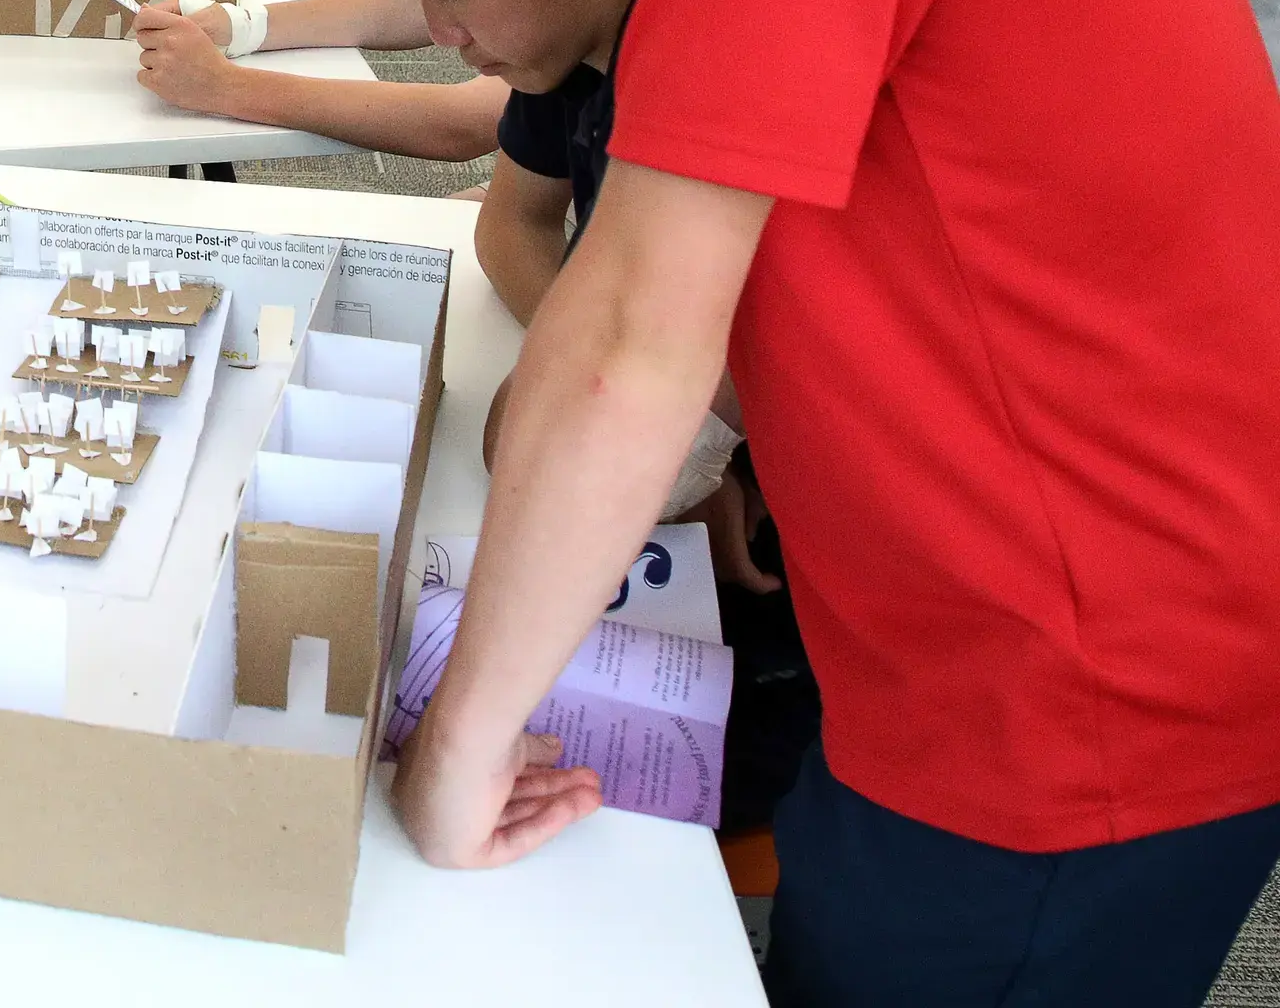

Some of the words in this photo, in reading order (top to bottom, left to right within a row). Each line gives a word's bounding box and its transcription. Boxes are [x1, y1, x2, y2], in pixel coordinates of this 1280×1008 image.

[40, 236, 53, 247] de
[55, 237, 115, 253] colaboración
[117, 243, 130, 255] de
[132, 244, 141, 256] la
[143, 247, 174, 258] marca
[221, 254, 240, 265] que
[242, 253, 279, 267] facilitan
[281, 257, 290, 268] la
[339, 264, 346, 276] y
[348, 265, 404, 279] generación
[406, 269, 419, 281] de
[94, 225, 124, 238] offerts
[126, 230, 141, 241] par
[144, 229, 153, 241] la
[155, 233, 193, 245] marque
[240, 238, 256, 251] qui
[258, 241, 282, 252] vous
[284, 241, 325, 255] facilitent
[369, 248, 388, 261] lors
[390, 251, 403, 263] de
[405, 253, 449, 268] réunions
